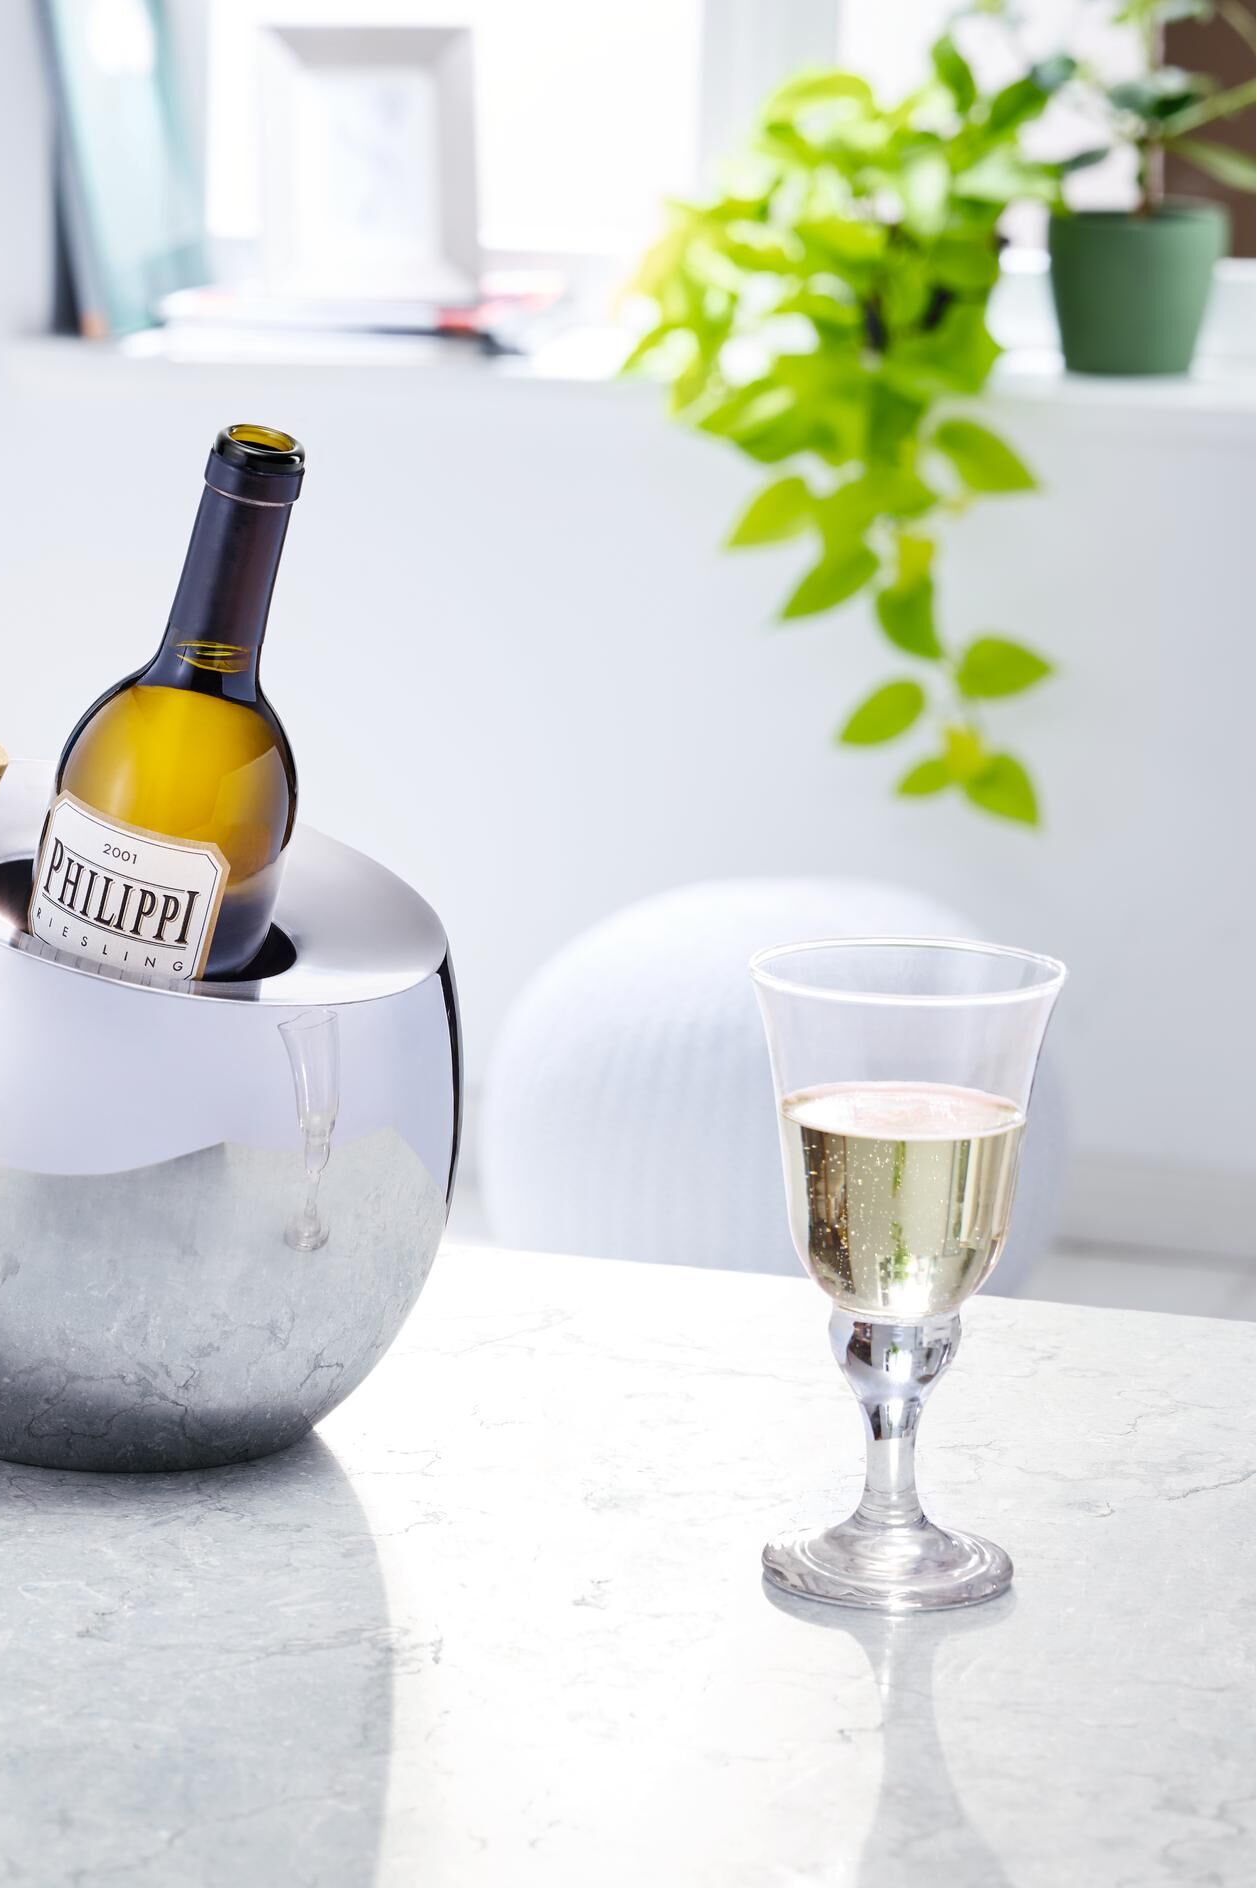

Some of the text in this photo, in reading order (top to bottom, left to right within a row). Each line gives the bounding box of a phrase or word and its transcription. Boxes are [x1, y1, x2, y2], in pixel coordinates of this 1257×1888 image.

[103, 843, 138, 865] 2001
[42, 837, 201, 945] PHILIPPI
[36, 907, 184, 972] RIESLING
